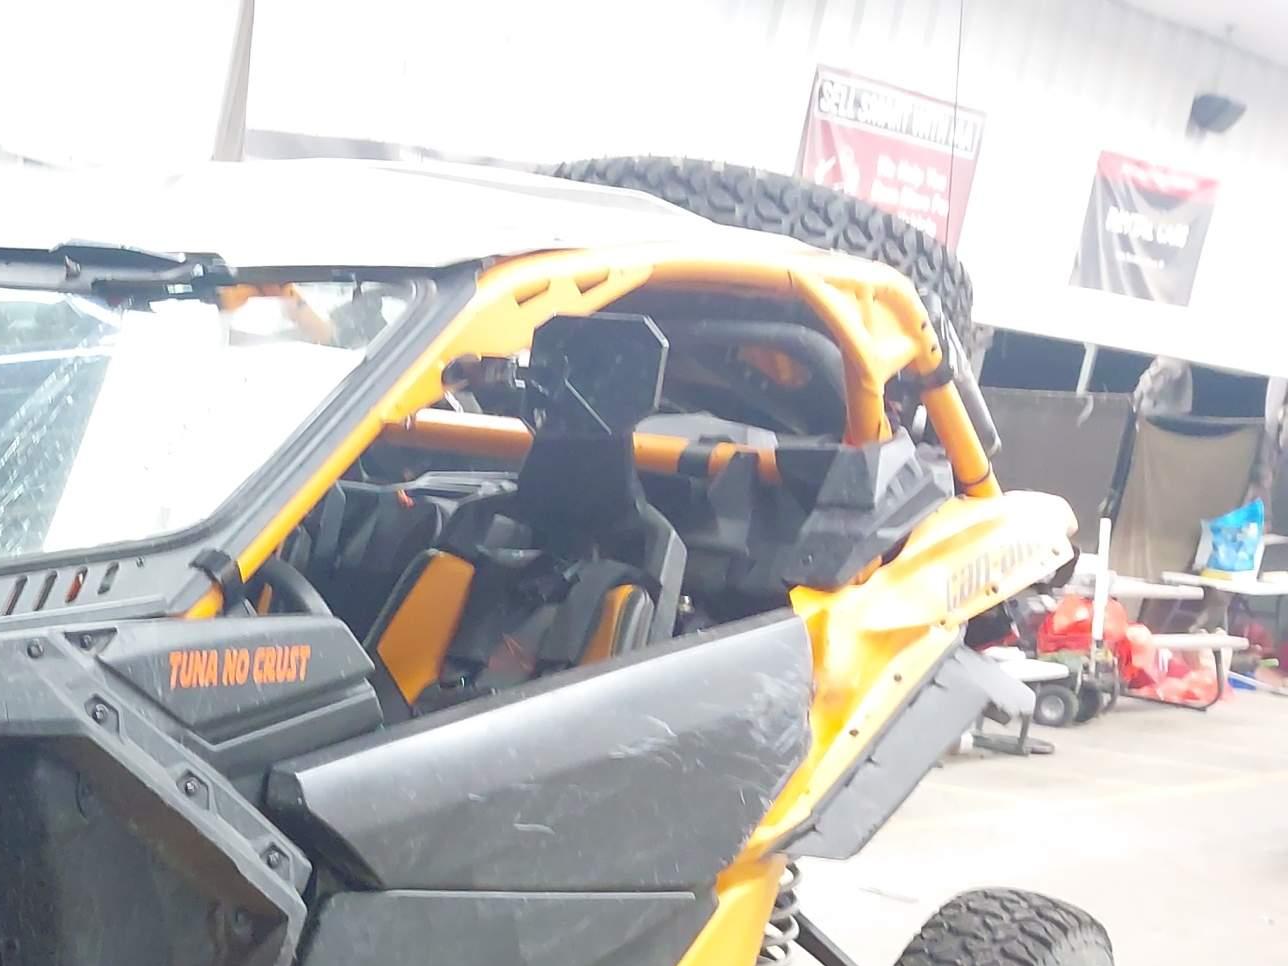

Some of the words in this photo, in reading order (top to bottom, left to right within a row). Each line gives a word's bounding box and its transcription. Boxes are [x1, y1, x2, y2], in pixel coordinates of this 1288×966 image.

[818, 79, 859, 122] SELL
[169, 649, 218, 691] TUNA
[222, 647, 250, 686] NO
[253, 643, 312, 684] CRUST
